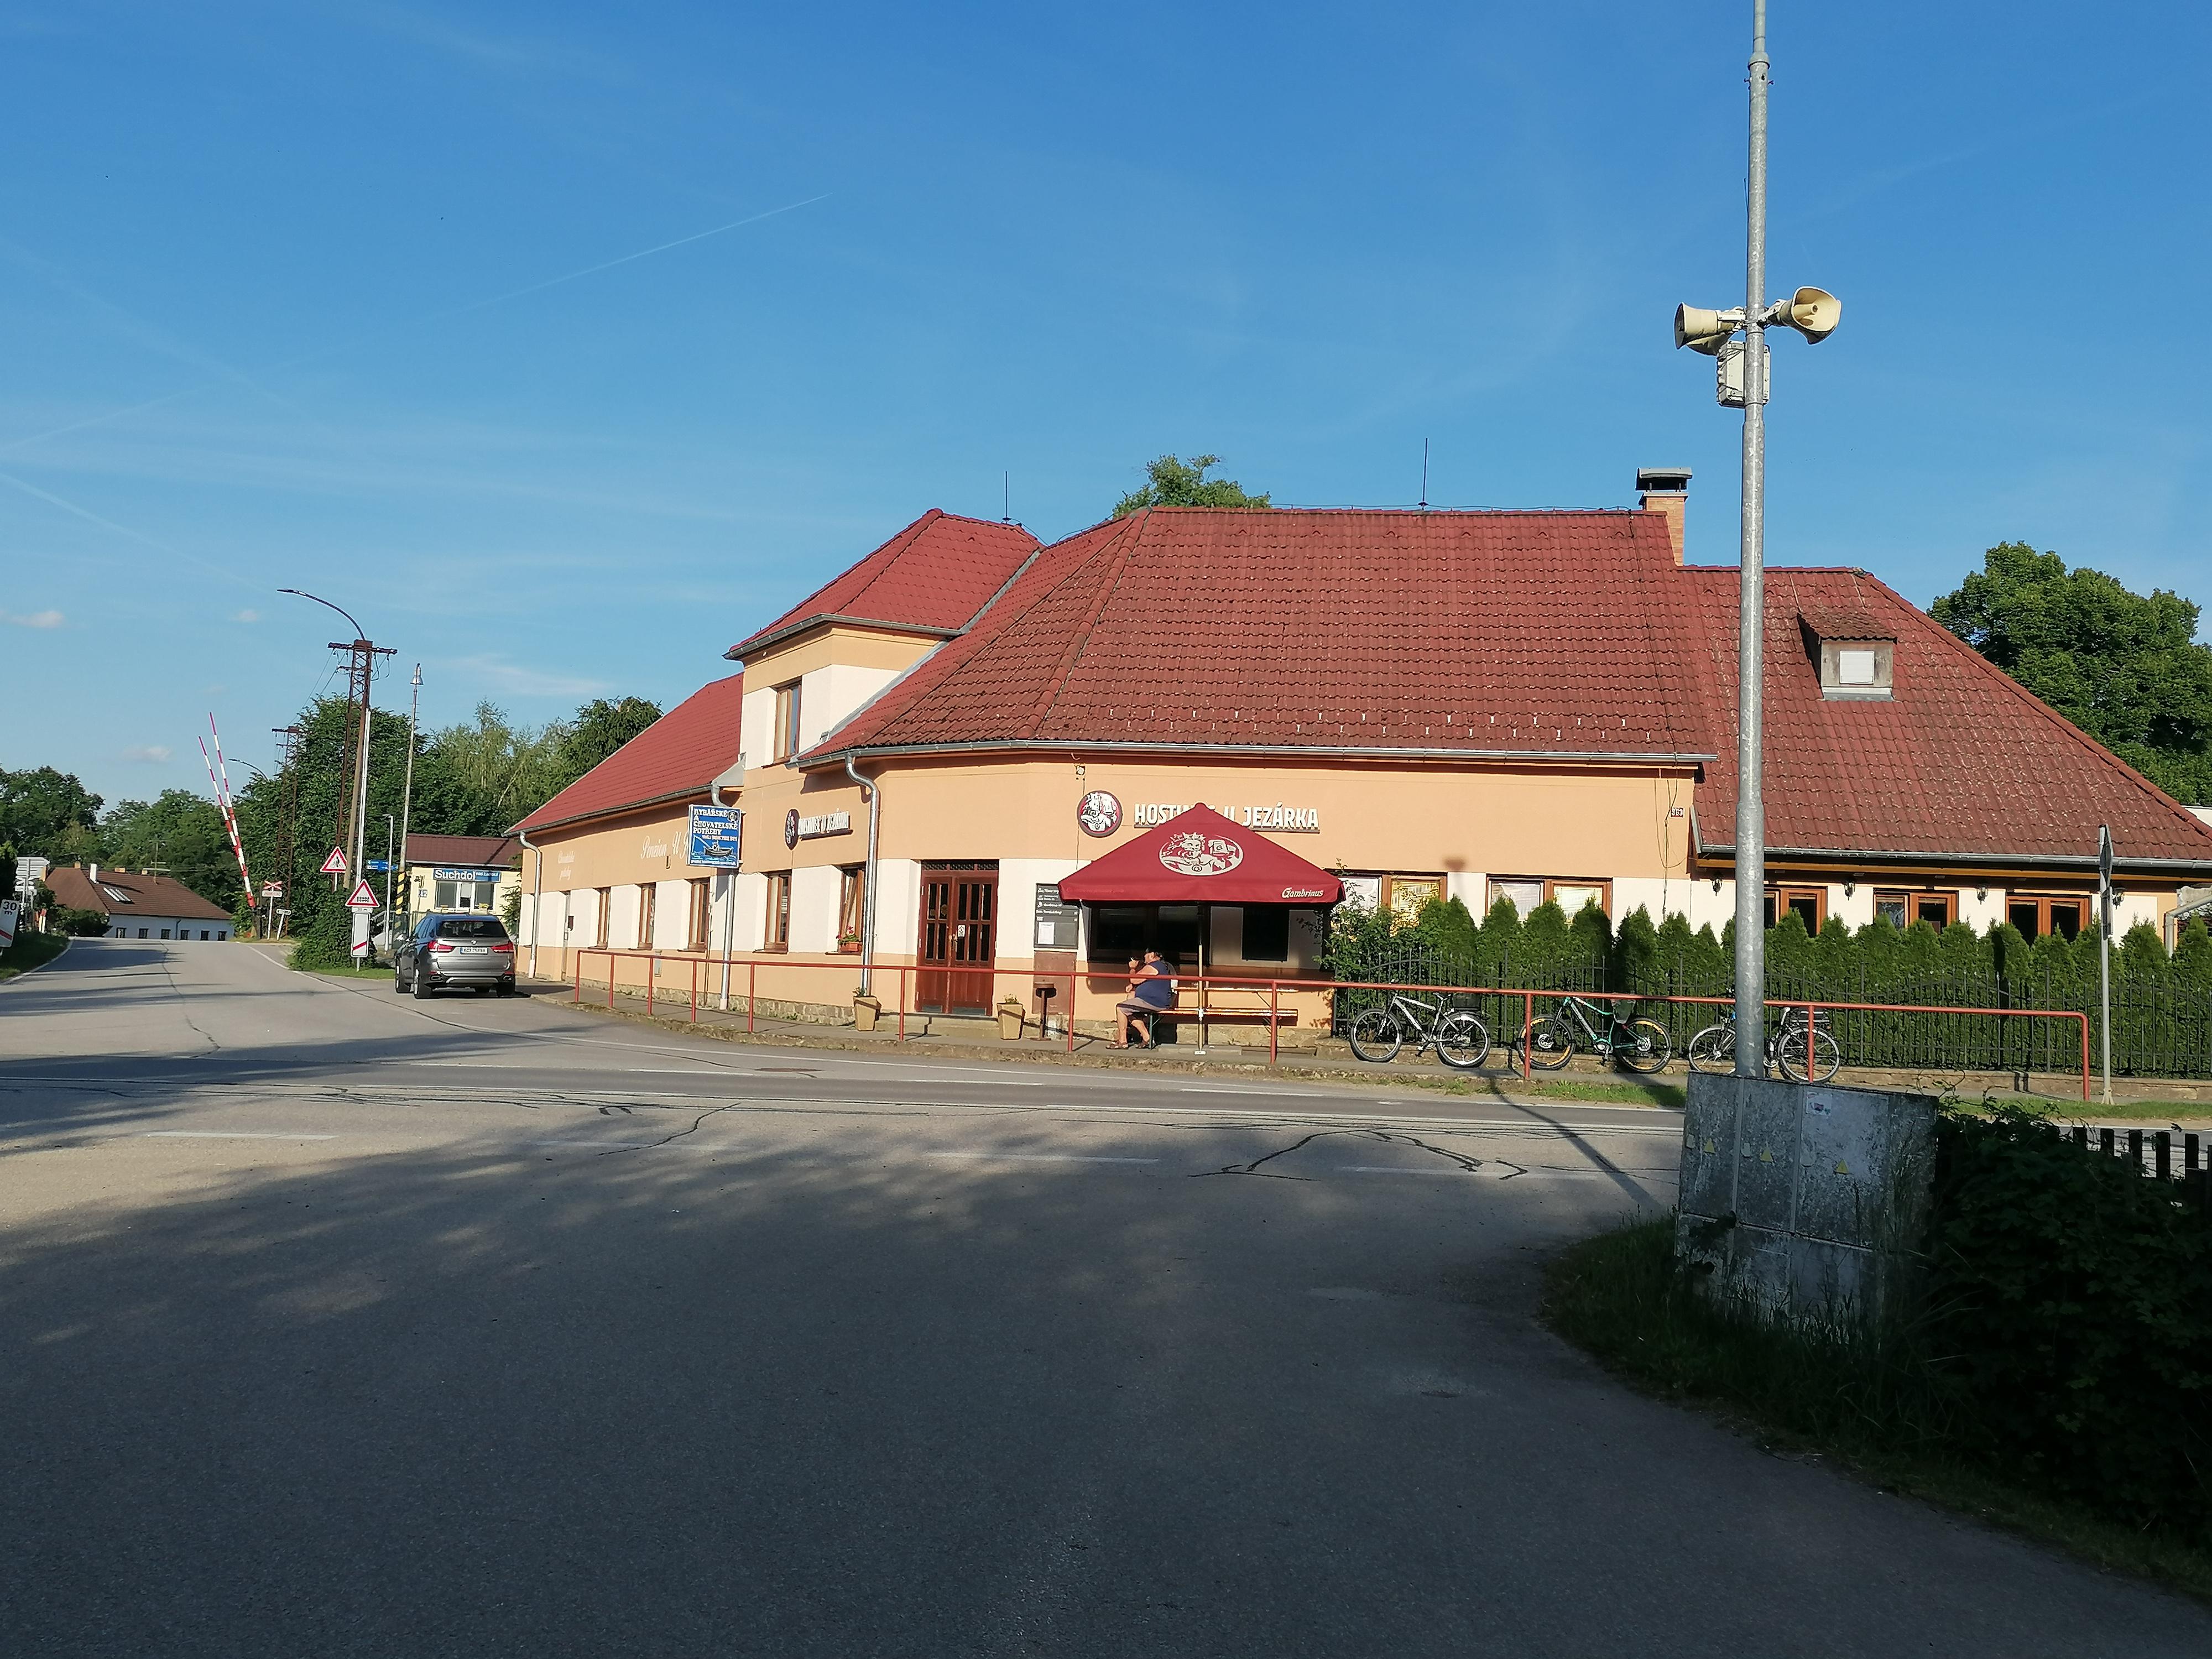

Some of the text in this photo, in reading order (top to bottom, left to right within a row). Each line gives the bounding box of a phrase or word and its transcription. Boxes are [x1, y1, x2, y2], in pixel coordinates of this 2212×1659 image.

[1243, 801, 1319, 828] JEZÁRKA
[434, 869, 476, 880] Suchdol
[1281, 887, 1324, 898] Gambrinus
[3, 901, 17, 911] 30
